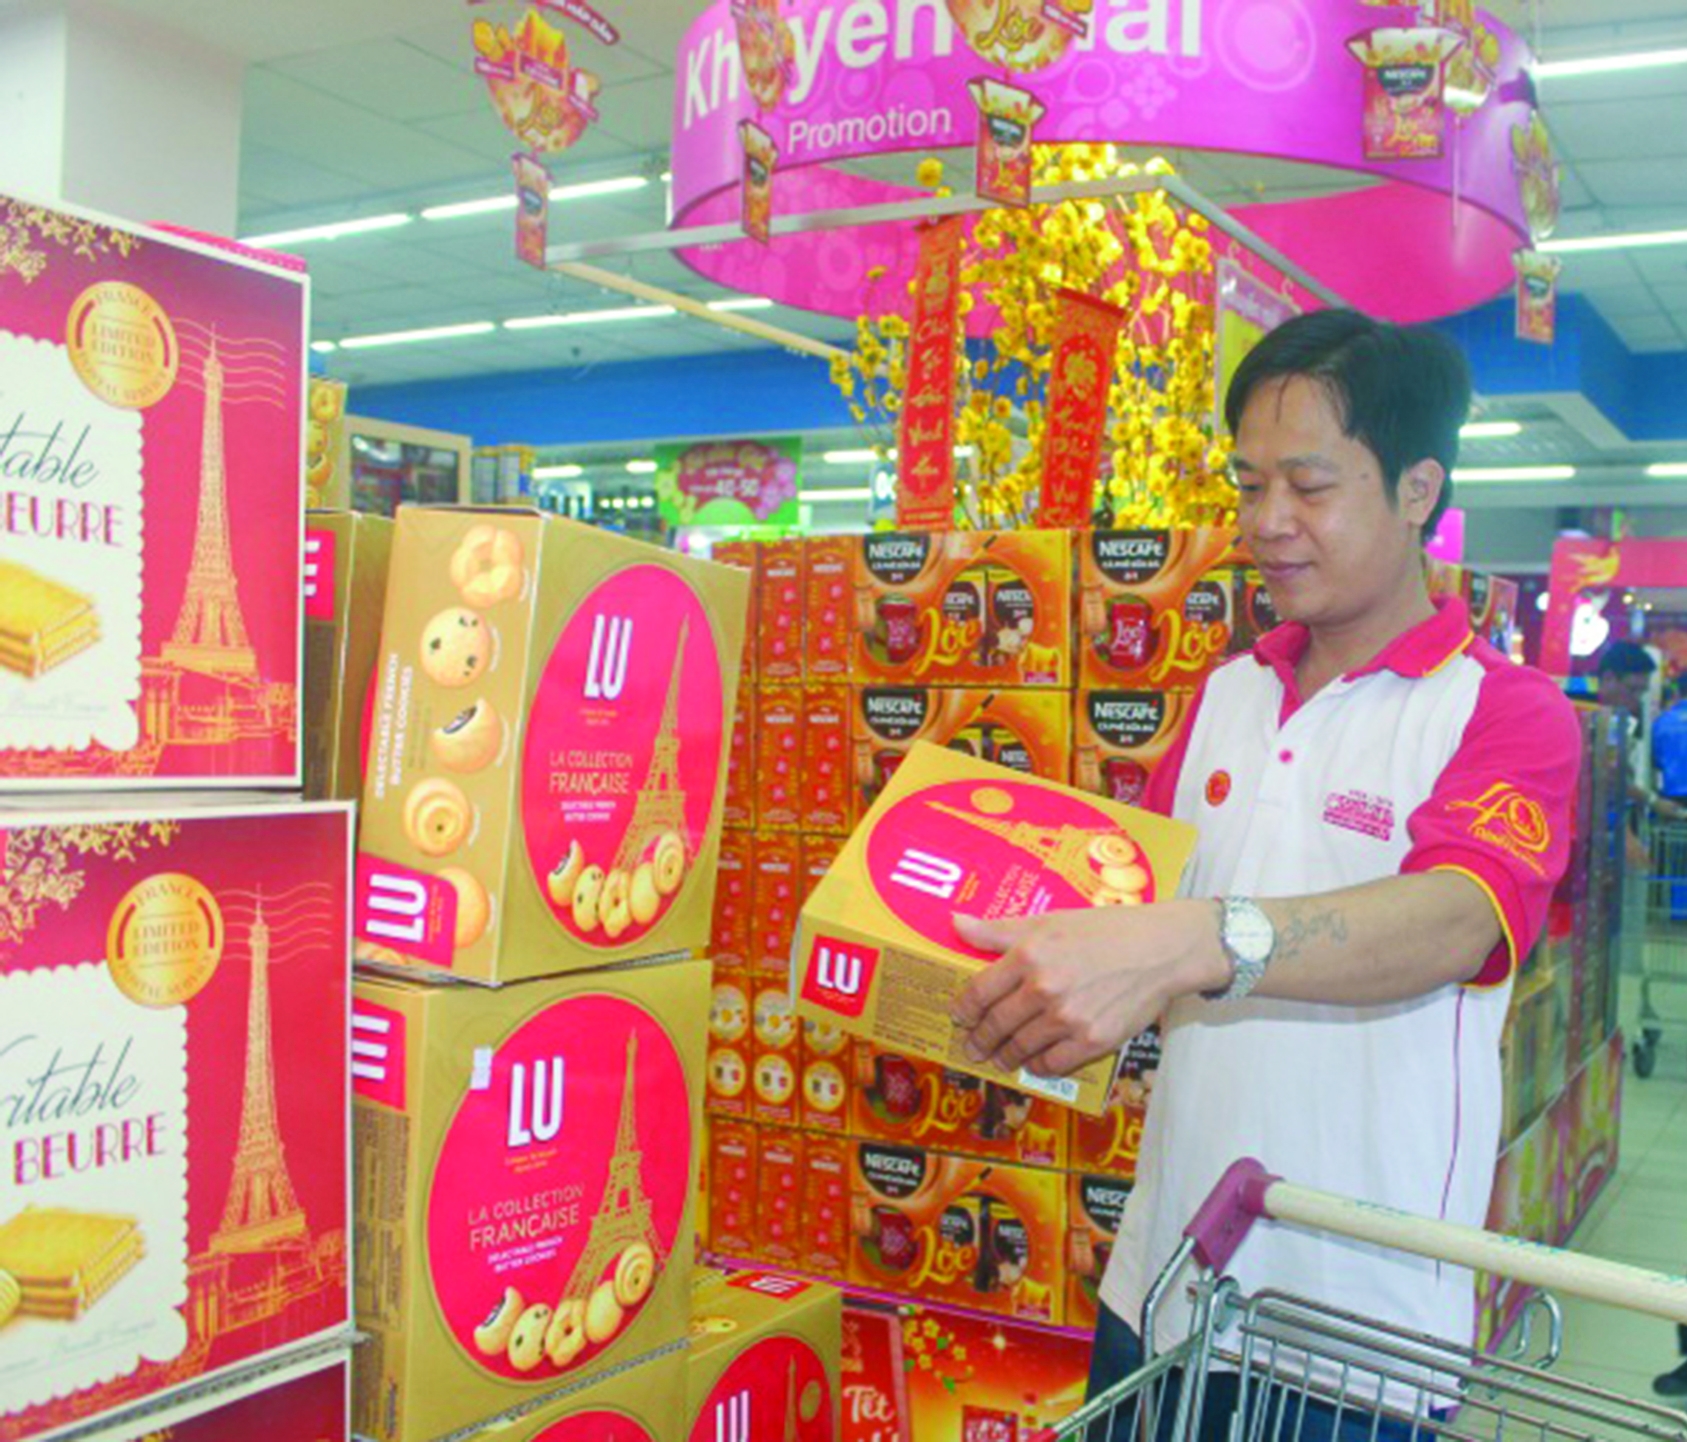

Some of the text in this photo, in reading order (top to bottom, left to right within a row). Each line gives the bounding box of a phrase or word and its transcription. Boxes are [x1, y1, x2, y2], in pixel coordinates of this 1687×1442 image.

[788, 104, 951, 154] Promotion
[583, 613, 633, 700] LU
[549, 750, 634, 769] LA COLLECTION
[549, 771, 630, 796] FRANÇAISE
[889, 848, 963, 899] LU
[366, 872, 428, 943] LU
[817, 946, 862, 995] LU
[508, 1055, 565, 1147] LU
[14, 1110, 167, 1186] BEURRE
[468, 1183, 584, 1226] LA COLLECTION
